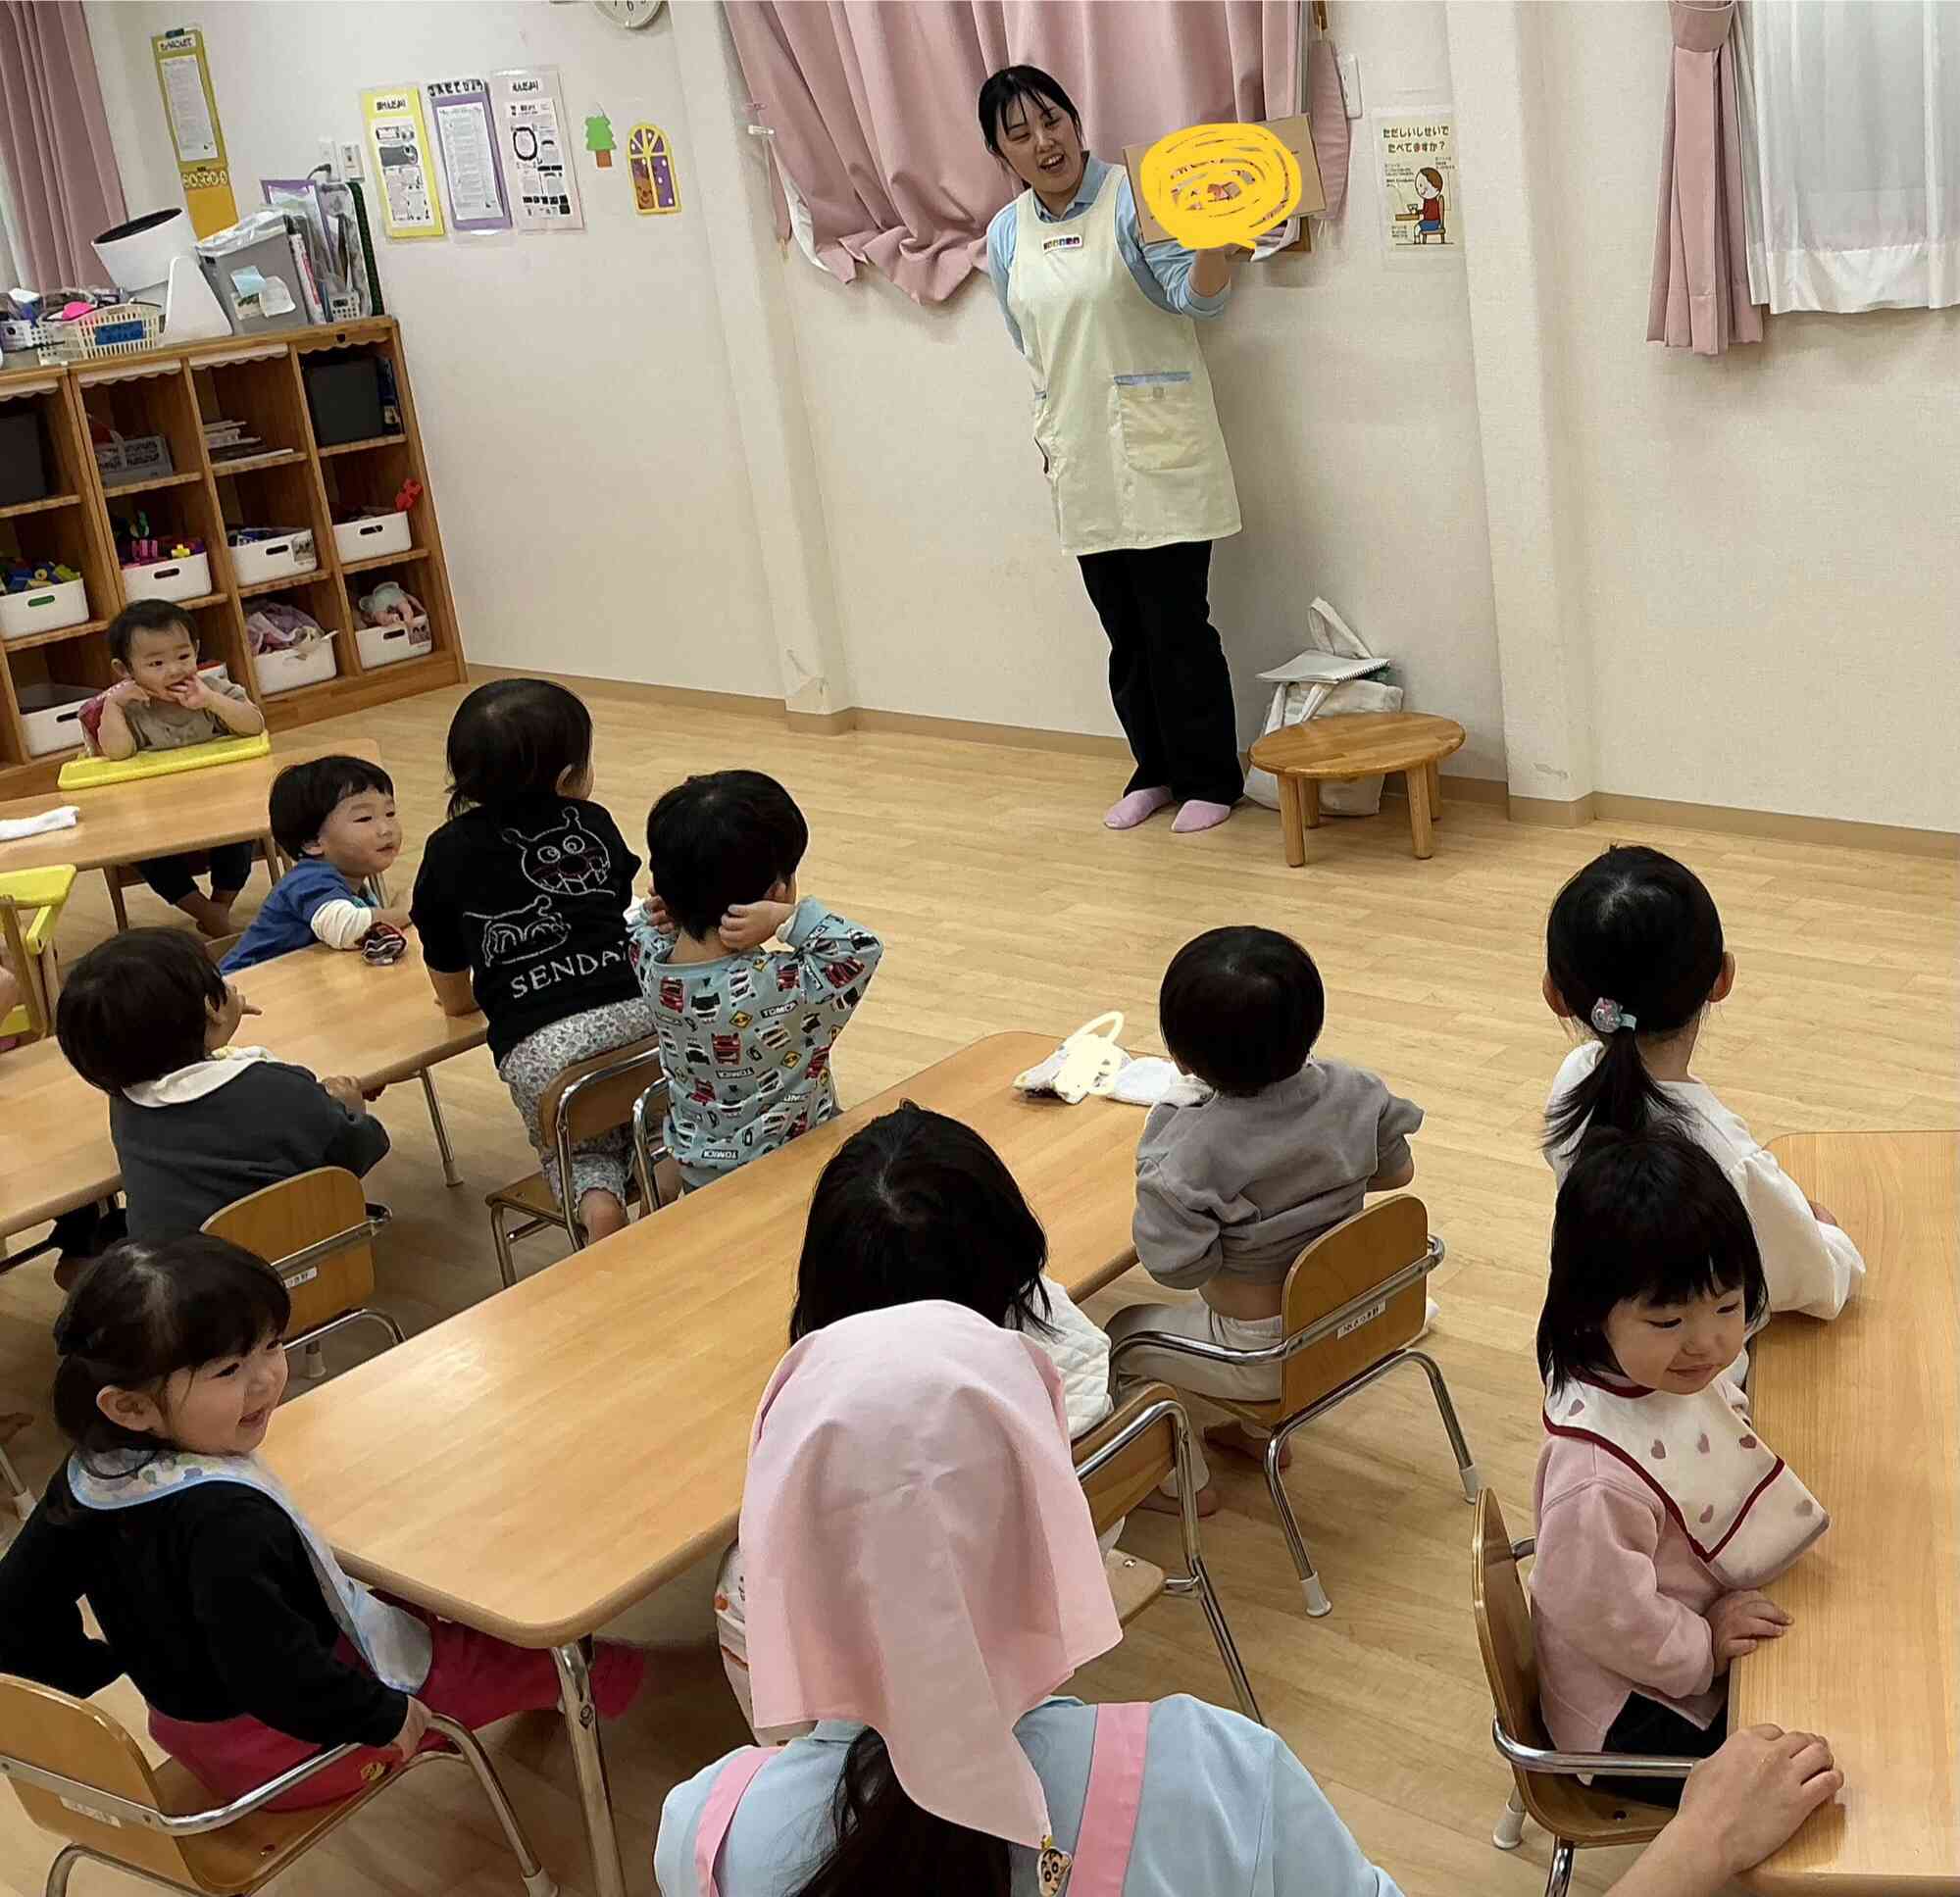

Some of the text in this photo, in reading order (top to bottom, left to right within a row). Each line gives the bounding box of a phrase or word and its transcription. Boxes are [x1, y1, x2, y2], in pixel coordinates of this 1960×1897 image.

[1382, 125, 1449, 138] ただしいしせいで
